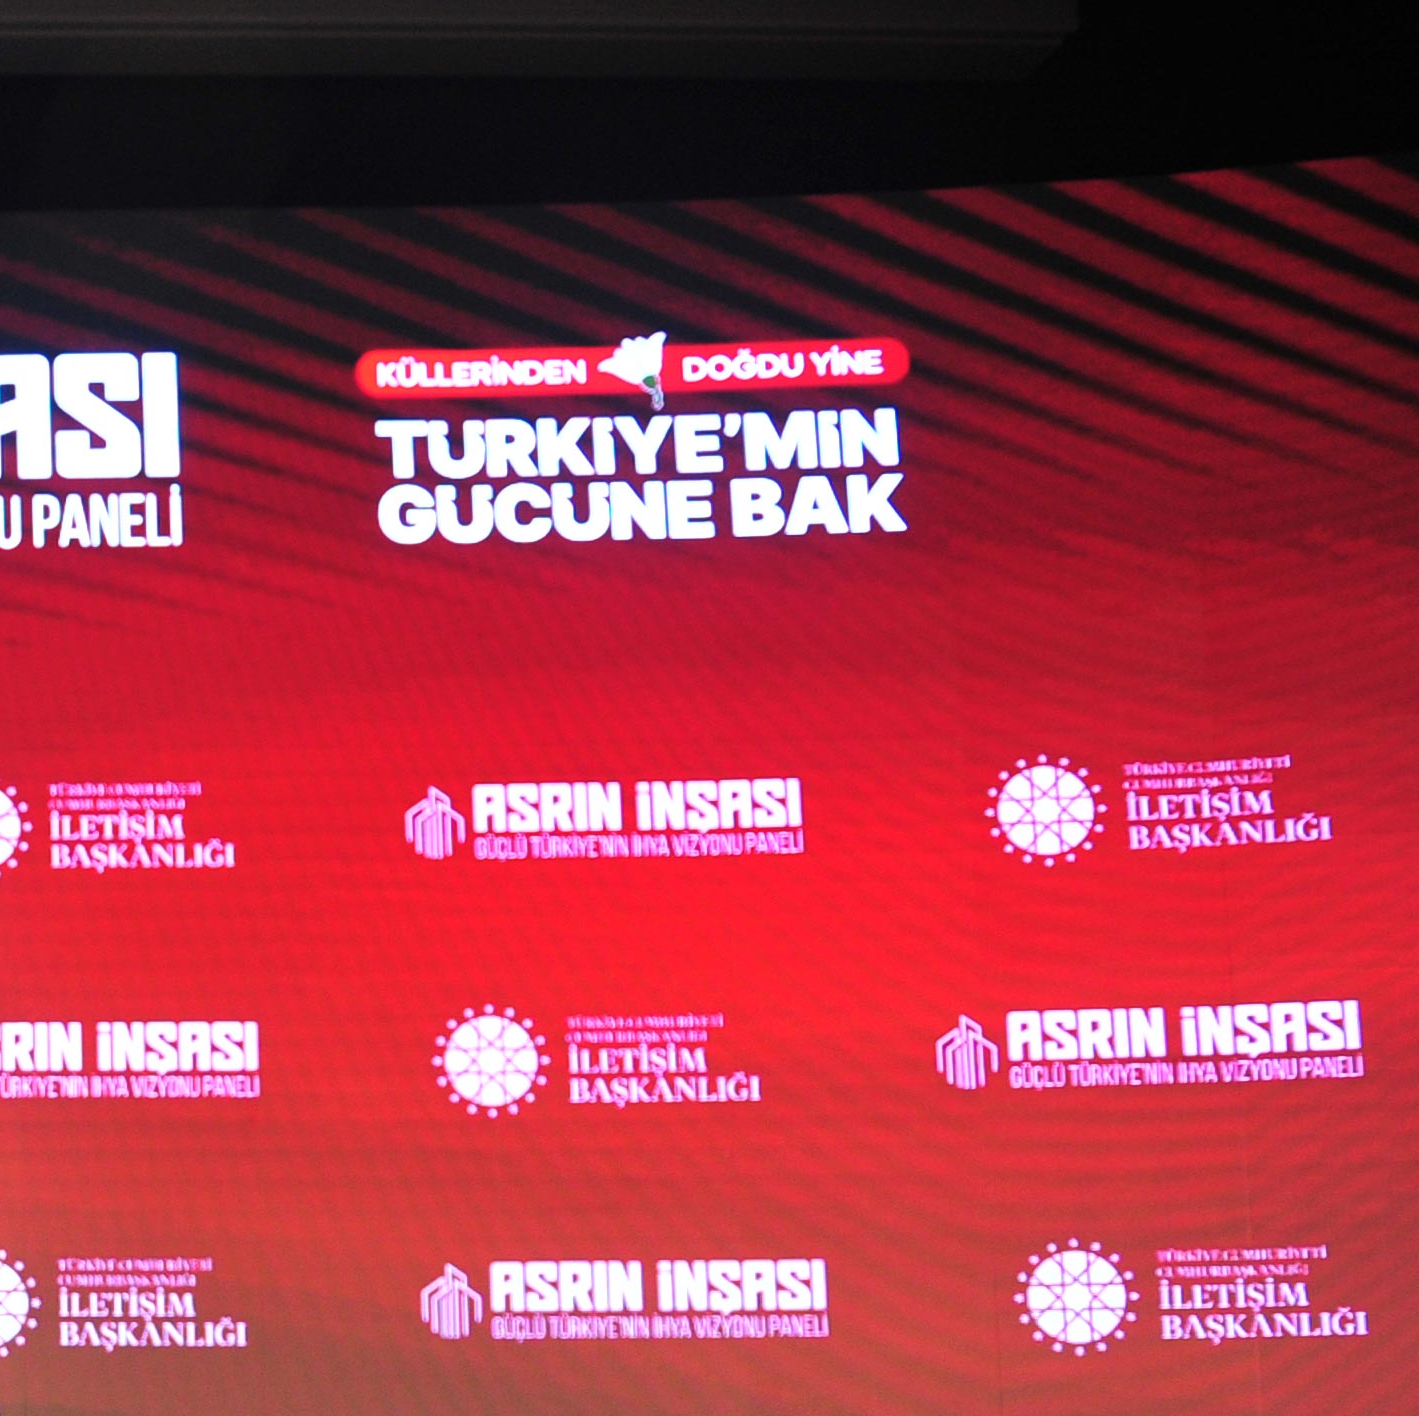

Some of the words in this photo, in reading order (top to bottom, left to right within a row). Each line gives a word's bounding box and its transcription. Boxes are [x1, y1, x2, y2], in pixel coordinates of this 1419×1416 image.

[375, 355, 587, 388] KÜLLERİNDEN
[681, 347, 805, 382] DOĞDU
[809, 344, 885, 377] YİNE
[30, 483, 184, 549] PANELİ
[729, 473, 908, 538] BAK
[471, 781, 622, 832] ASRIN
[1126, 786, 1275, 821] İLETİŞİM
[50, 810, 185, 842] İLETİŞİM
[1128, 812, 1333, 853] BAŞKANLIĞI
[50, 838, 236, 872] BAŞKANLIĞI
[96, 1020, 259, 1076] İNŞASI
[1006, 1007, 1167, 1061] ASRIN
[568, 1043, 708, 1077] İLETİŞİM
[569, 1073, 761, 1108] BAŞKANLIĞI
[58, 1286, 196, 1320] İLETİŞİM
[489, 1260, 643, 1312] ASRIN
[1158, 1277, 1310, 1312] İLETİŞİM
[58, 1316, 246, 1353] BAŞKANLIĞI
[1159, 1306, 1369, 1346] BAŞKANLIĞI
